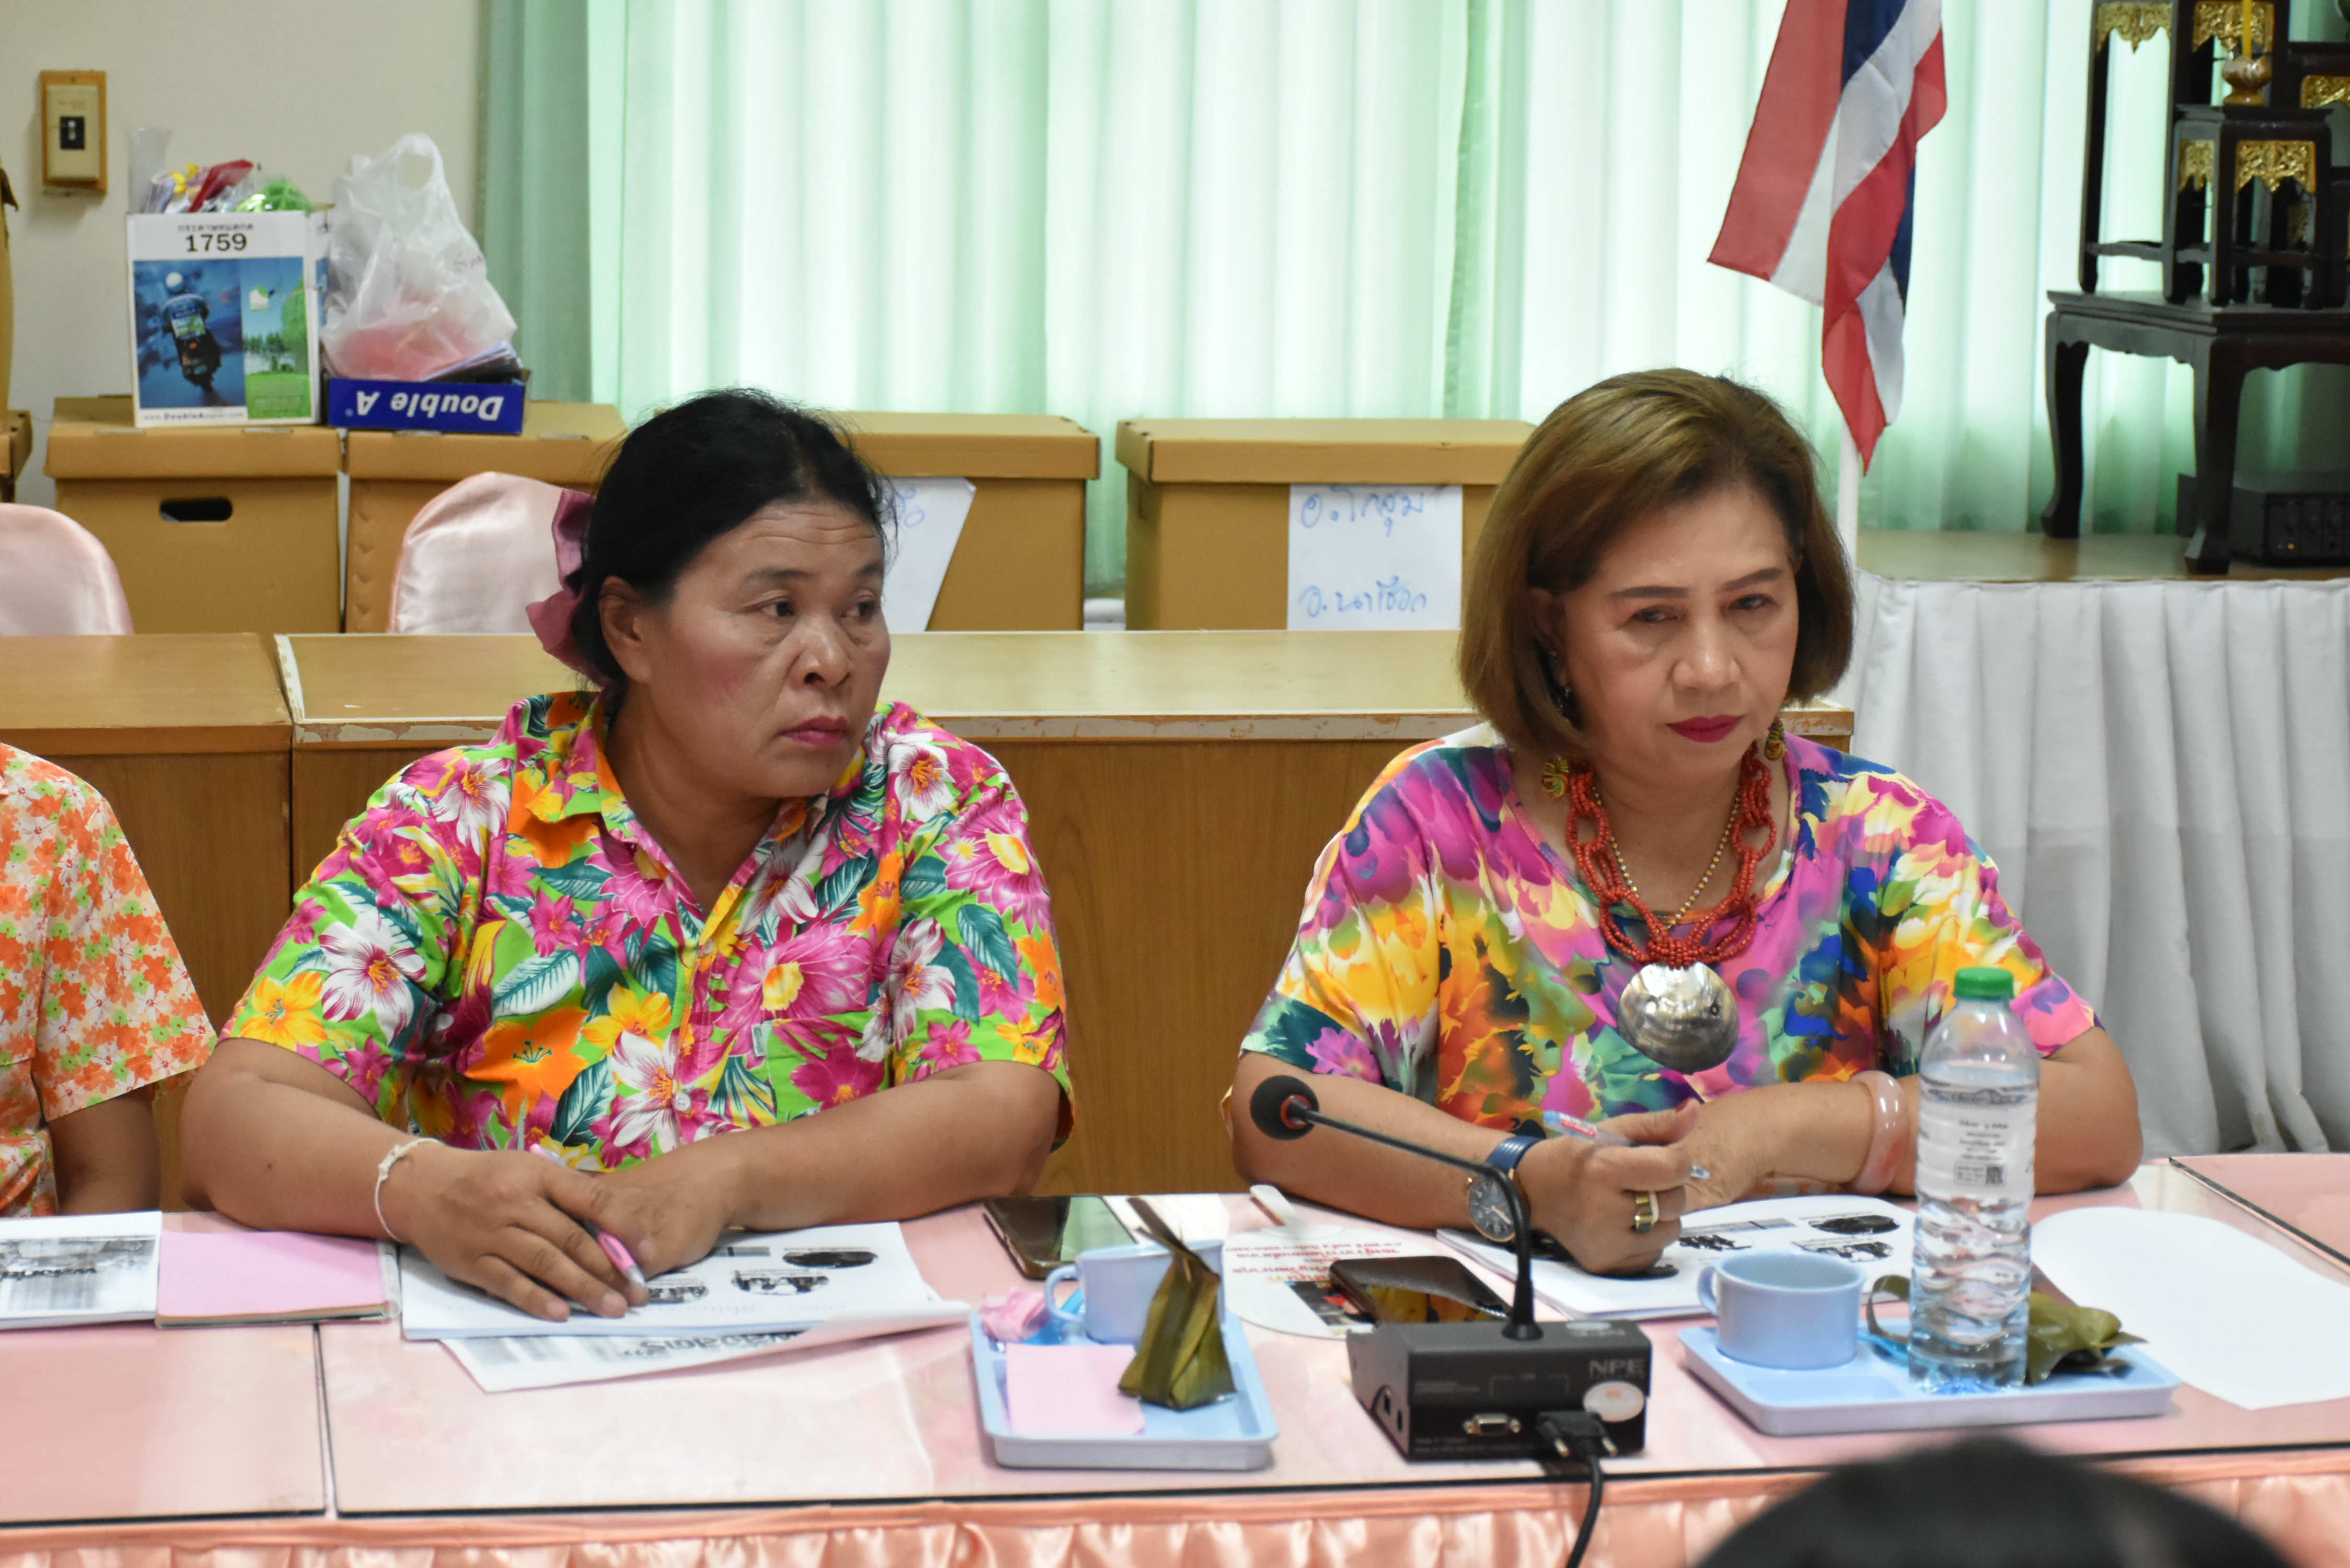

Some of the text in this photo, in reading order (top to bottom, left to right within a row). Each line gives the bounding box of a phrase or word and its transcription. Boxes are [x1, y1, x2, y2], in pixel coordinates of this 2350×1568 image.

[186, 233, 248, 252] 1759
[356, 390, 504, 421] Double A
[1588, 1358, 1645, 1376] NPE
